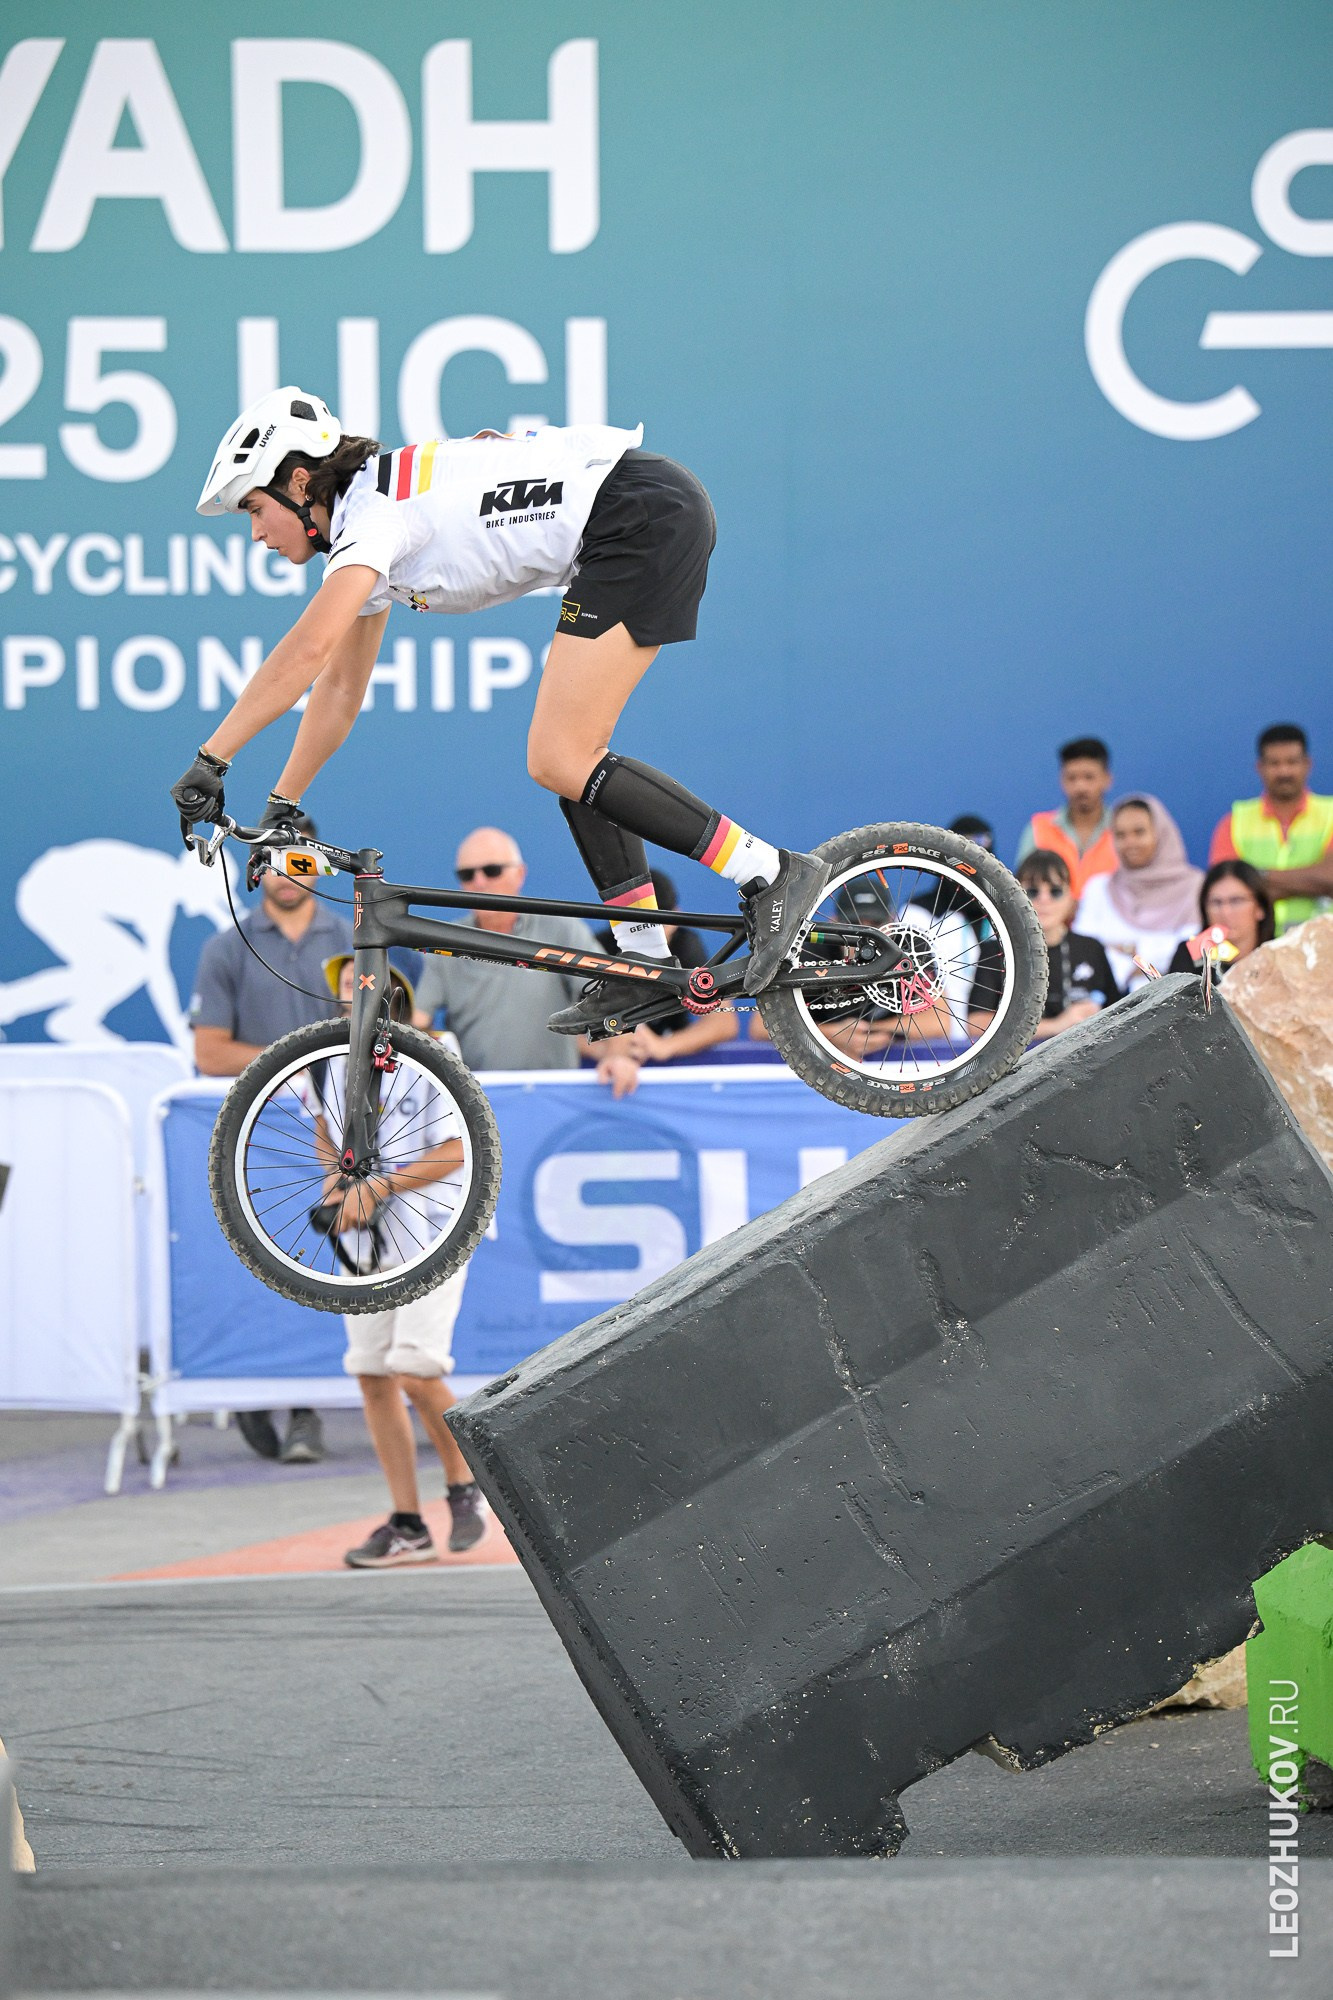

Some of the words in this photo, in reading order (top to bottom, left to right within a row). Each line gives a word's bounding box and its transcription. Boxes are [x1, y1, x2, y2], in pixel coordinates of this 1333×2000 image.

[259, 424, 277, 448] uvex
[479, 478, 564, 517] KTM
[486, 518, 505, 528] BIKE
[509, 510, 556, 525] INDUSTRIES
[585, 769, 607, 806] hebo
